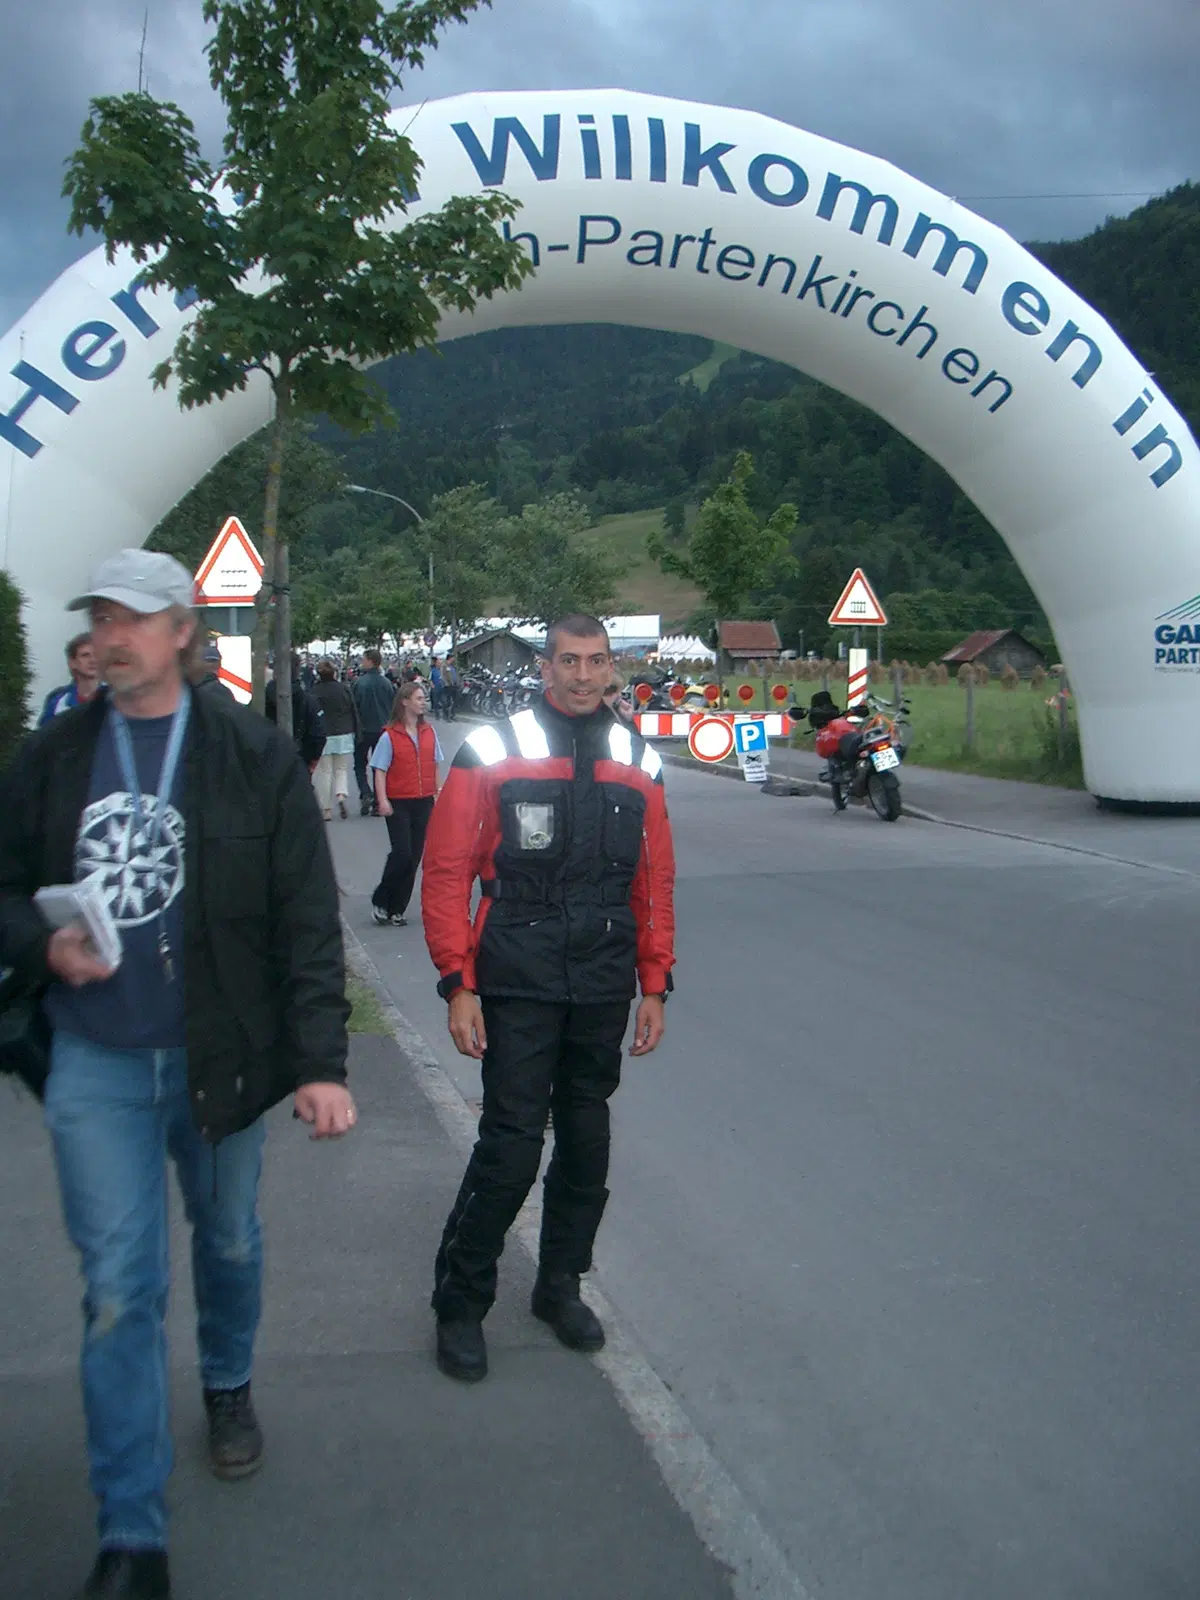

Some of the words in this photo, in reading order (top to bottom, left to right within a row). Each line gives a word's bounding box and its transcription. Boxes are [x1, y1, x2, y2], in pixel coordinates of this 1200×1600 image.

[450, 113, 1103, 389] Willkommen
[1112, 387, 1184, 488] in
[502, 214, 1014, 414] h-Partenkirchen
[1155, 647, 1200, 664] PART
[740, 724, 761, 752] P
